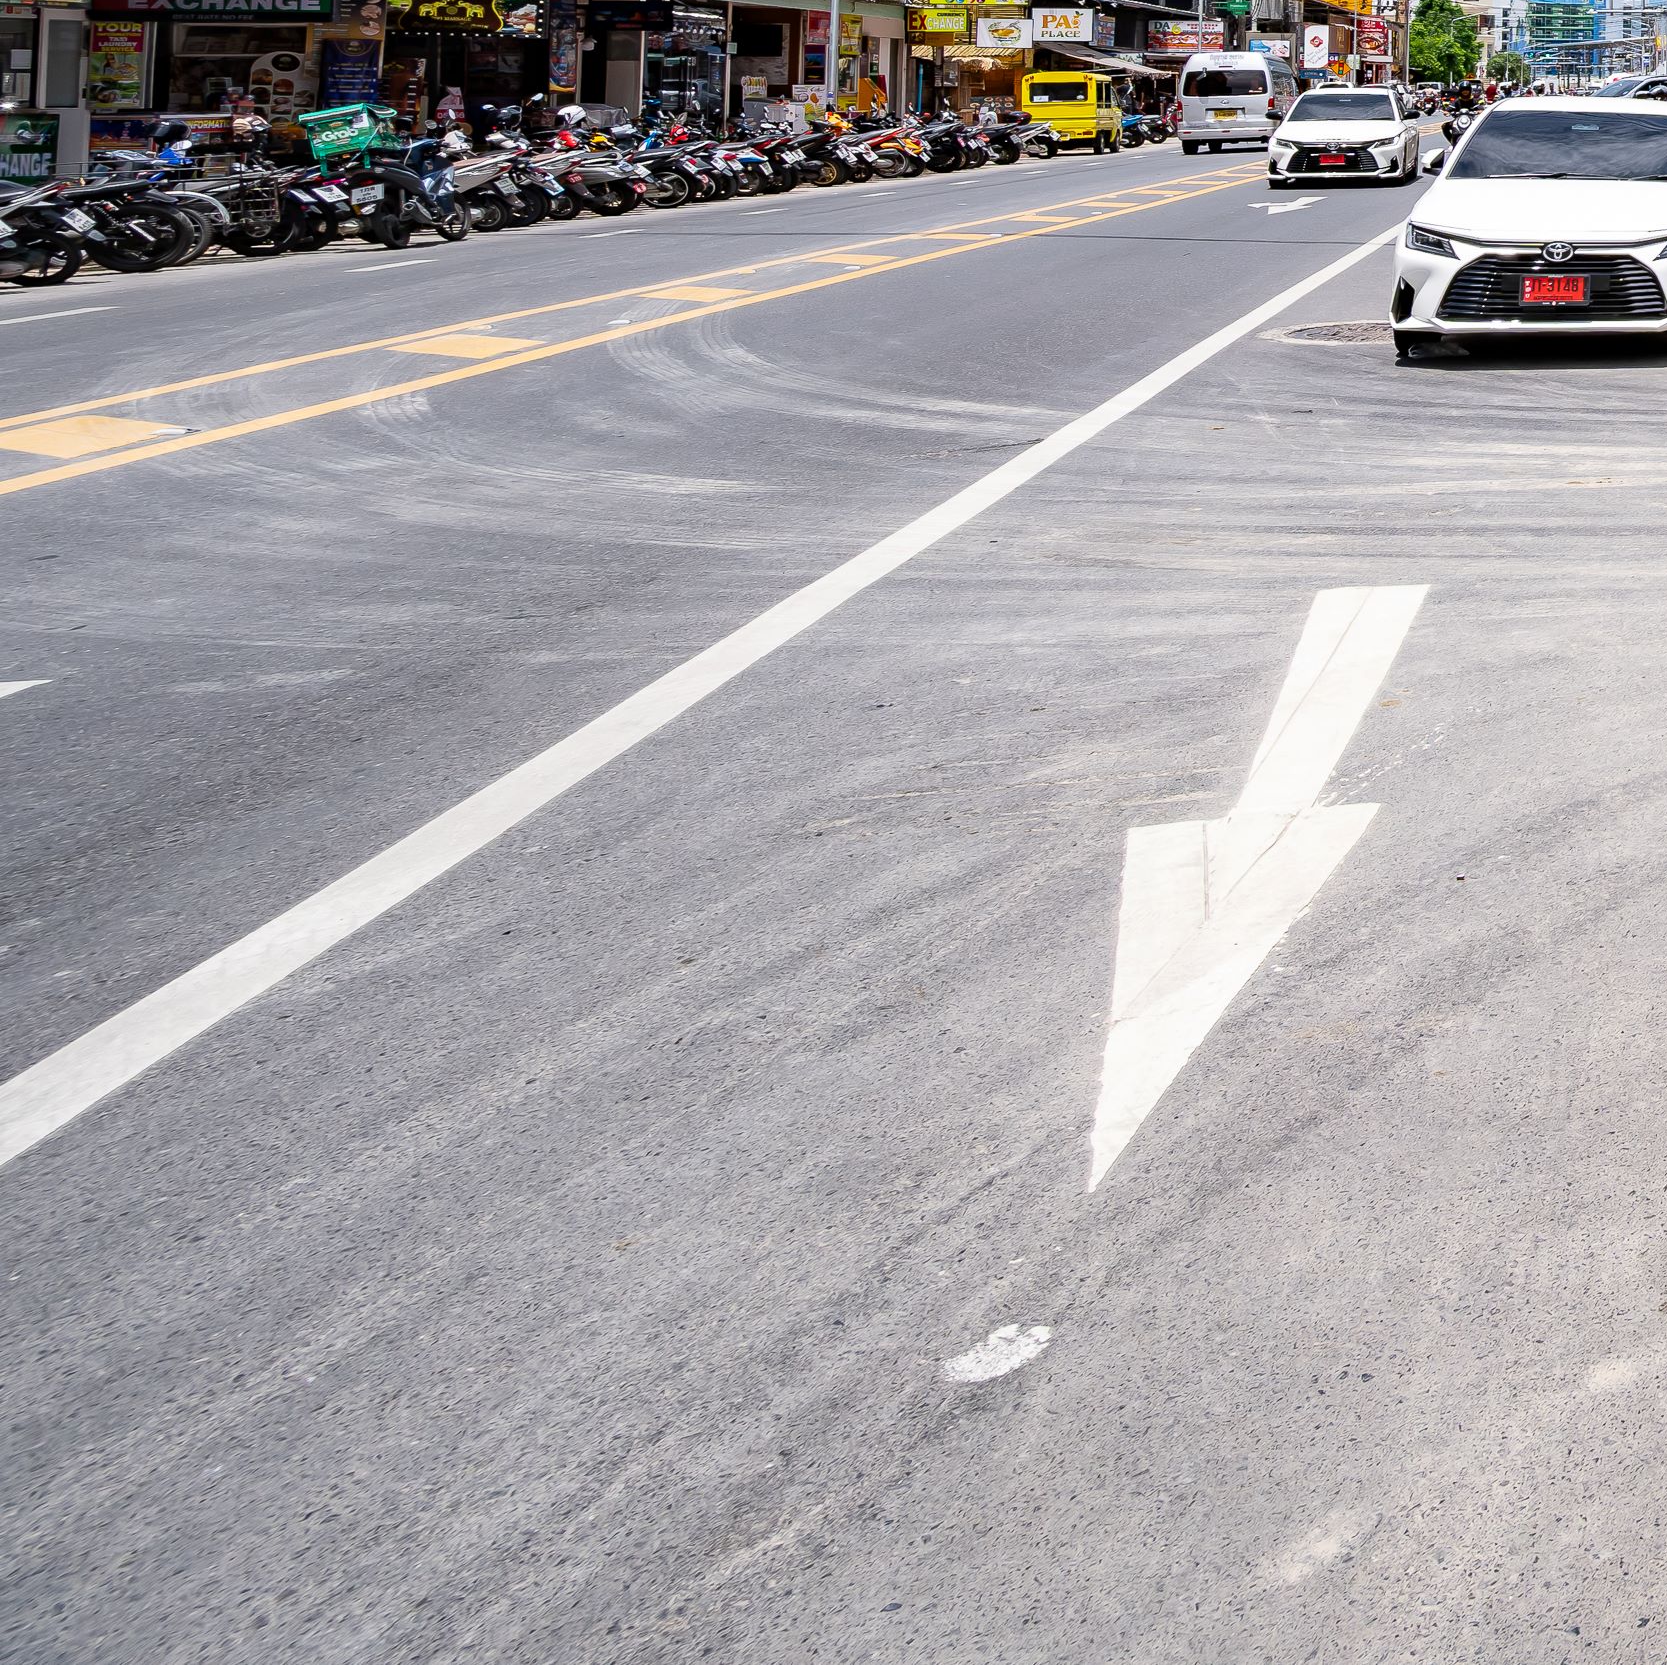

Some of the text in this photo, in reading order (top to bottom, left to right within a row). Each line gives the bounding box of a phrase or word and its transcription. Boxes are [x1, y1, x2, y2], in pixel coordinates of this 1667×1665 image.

[95, 21, 142, 32] TOUR
[1040, 30, 1081, 39] PLACE
[321, 126, 359, 142] Grab
